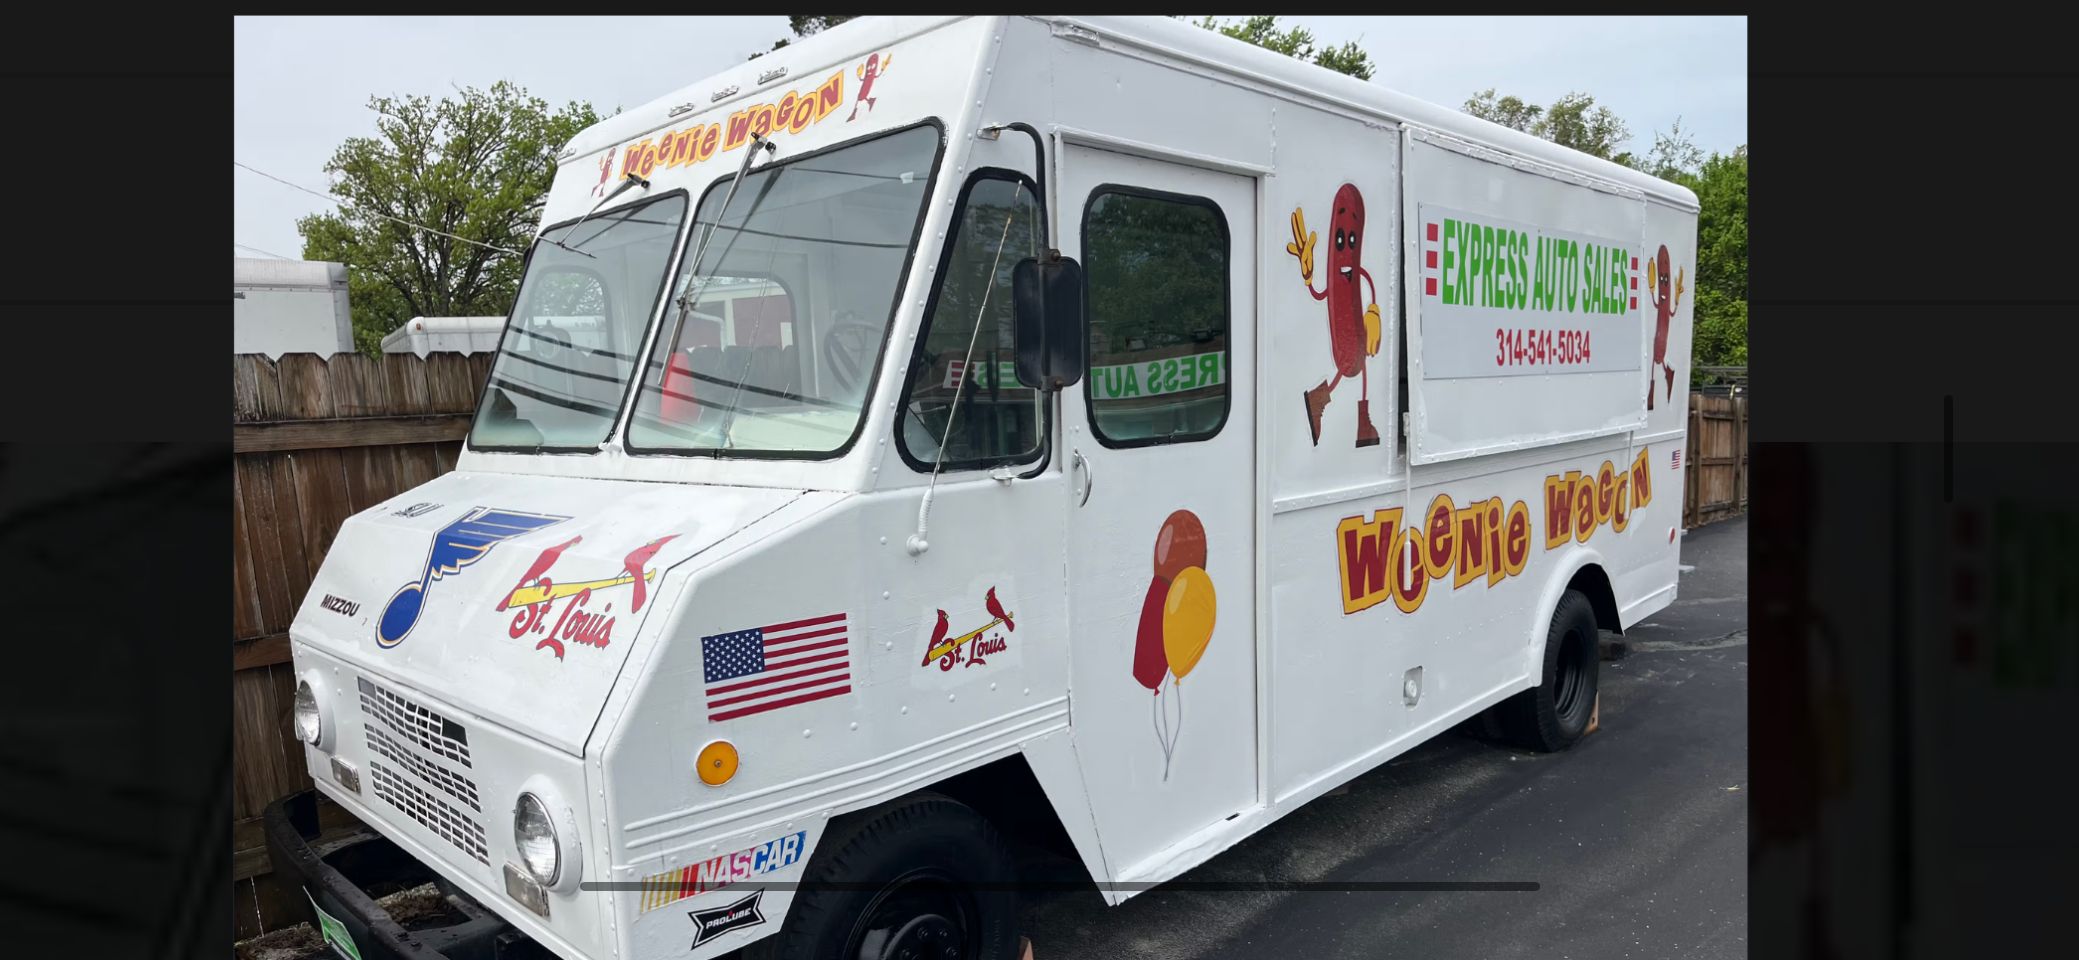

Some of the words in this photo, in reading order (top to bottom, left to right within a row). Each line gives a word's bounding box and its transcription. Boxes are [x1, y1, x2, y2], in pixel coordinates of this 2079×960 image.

[1442, 218, 1529, 311] EXPRESS
[1532, 235, 1579, 314] AUTO
[1582, 242, 1628, 315] SALES
[1496, 328, 1591, 367] 314-541-5034
[320, 594, 361, 618] MIZZOU
[509, 577, 557, 639] St.
[536, 587, 616, 663] Louis
[939, 637, 965, 672] St.
[965, 632, 1008, 669] Louis
[697, 833, 801, 893] NASCAR
[705, 907, 752, 930] PROLUBE
